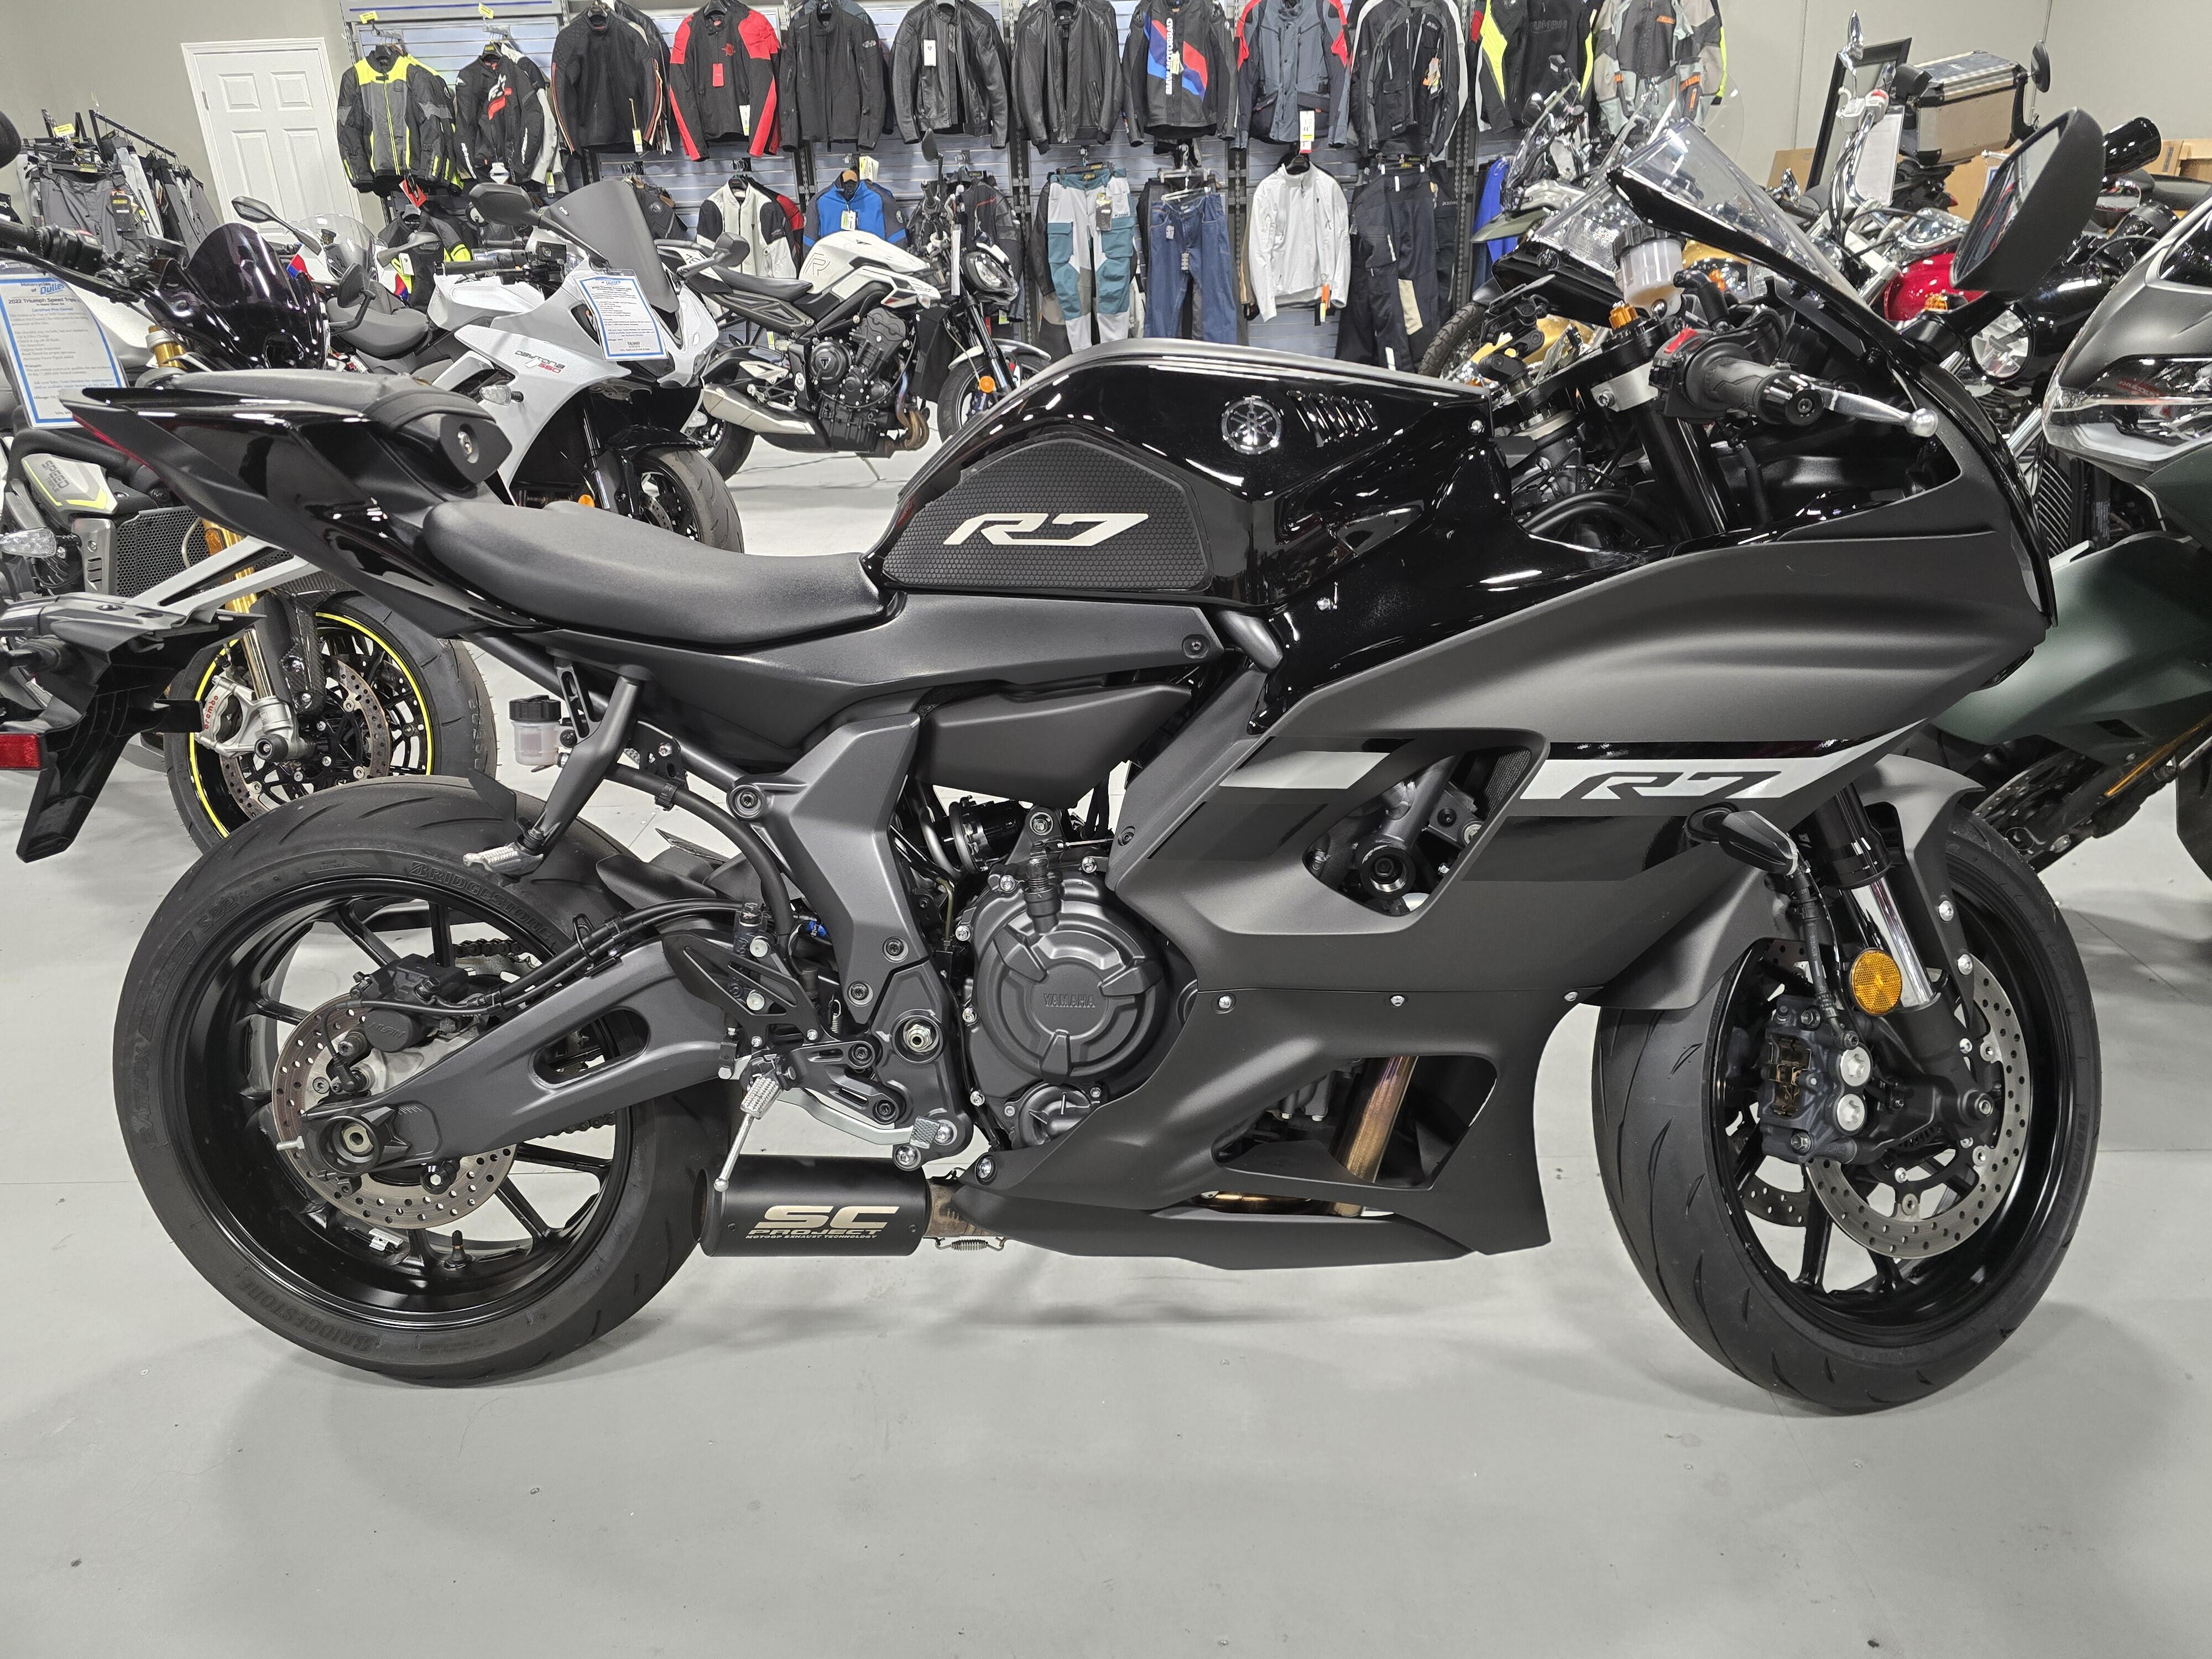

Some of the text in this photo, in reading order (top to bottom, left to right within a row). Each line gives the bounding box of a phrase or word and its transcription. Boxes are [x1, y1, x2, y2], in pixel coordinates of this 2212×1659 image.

[40, 283, 65, 295] Dulles
[41, 460, 70, 489] SPEED
[943, 513, 1149, 546] R7
[204, 695, 219, 730] brembo
[1559, 771, 1782, 800] R7
[410, 860, 555, 940] BRIDGESTONE
[1043, 993, 1095, 1008] YAMAHA
[754, 1205, 900, 1229] SC
[234, 1276, 377, 1355] BRIDGESTONE
